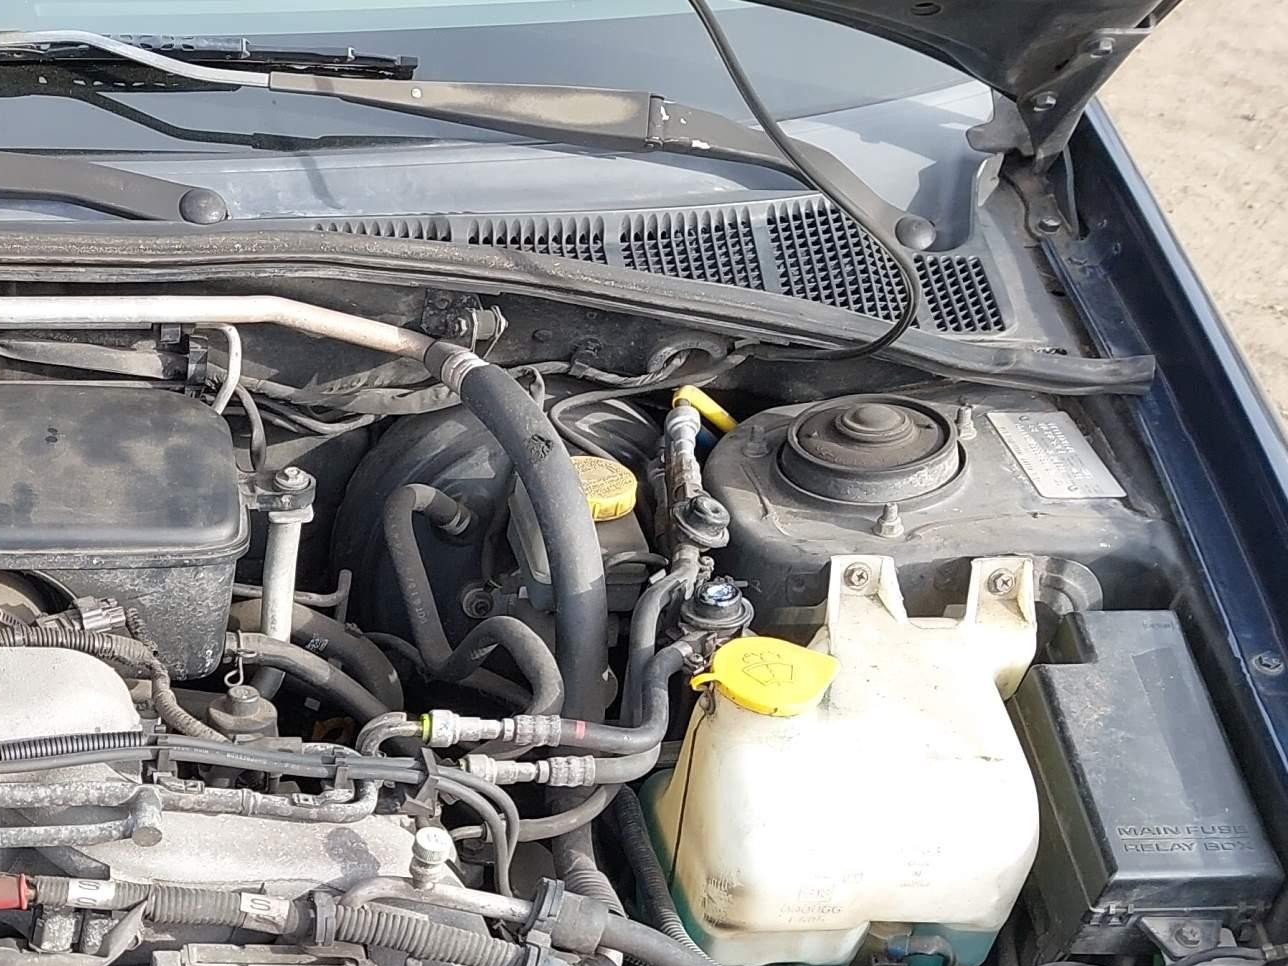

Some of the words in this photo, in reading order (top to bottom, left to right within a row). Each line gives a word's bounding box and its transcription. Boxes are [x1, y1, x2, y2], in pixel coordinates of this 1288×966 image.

[1116, 824, 1182, 836] MAIN
[1184, 824, 1250, 836] FUSE
[1122, 840, 1198, 853] RELAY
[1202, 840, 1256, 852] BOX
